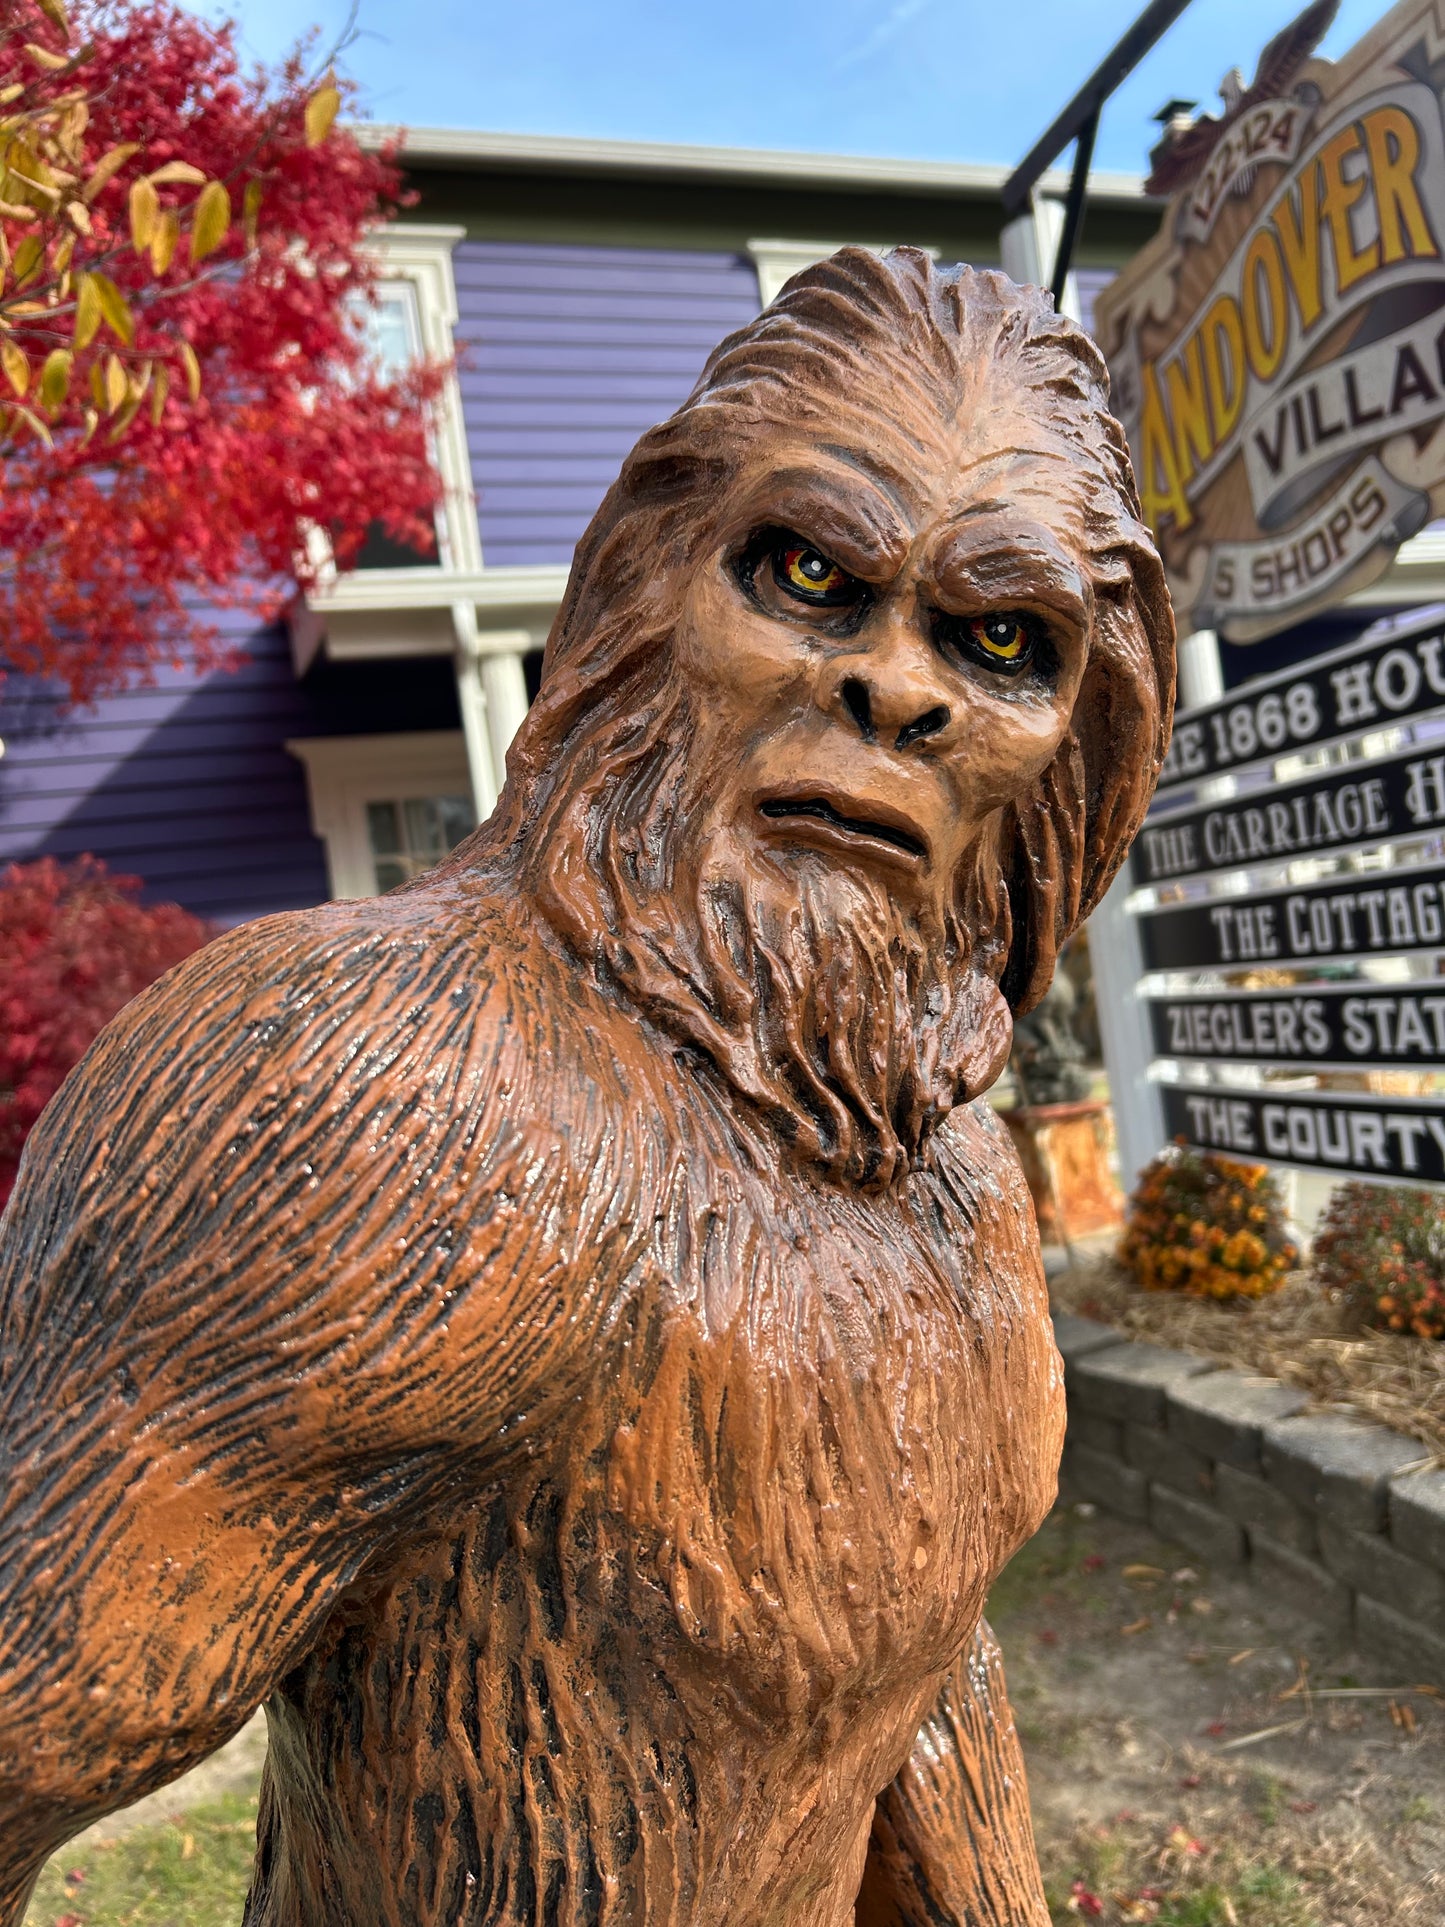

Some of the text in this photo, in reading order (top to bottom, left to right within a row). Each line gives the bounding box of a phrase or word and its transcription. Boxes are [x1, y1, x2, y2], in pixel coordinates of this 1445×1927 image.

[1141, 106, 1438, 530] ANDOVER
[1255, 322, 1445, 478] VILLA
[1251, 476, 1387, 599] SHOPS
[1161, 725, 1206, 776] HE
[1210, 682, 1321, 762] 1868
[1145, 824, 1199, 874] THE
[1204, 777, 1392, 866] CARRIAGE
[1211, 904, 1278, 960] THE
[1167, 997, 1331, 1055] ZIEGLER'S
[1187, 1099, 1254, 1149] THE
